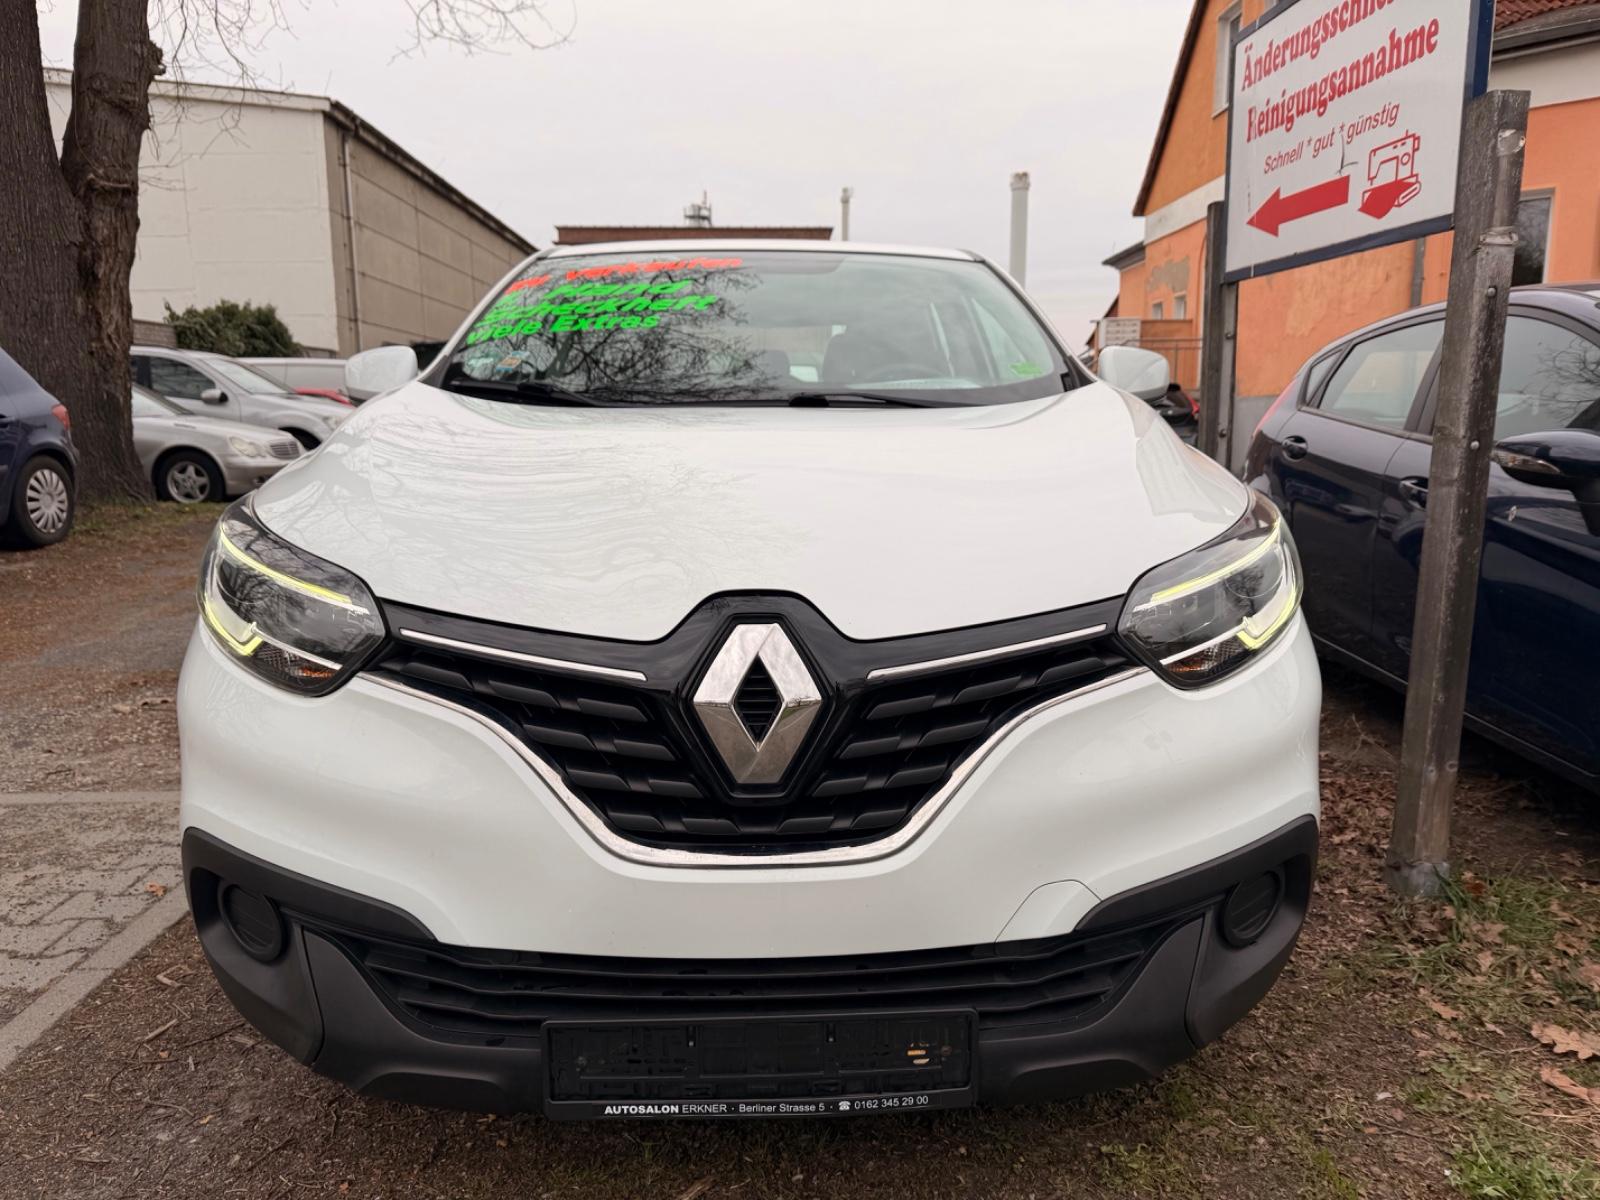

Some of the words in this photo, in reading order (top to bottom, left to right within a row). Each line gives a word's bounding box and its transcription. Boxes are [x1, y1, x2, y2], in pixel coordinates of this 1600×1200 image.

[1241, 0, 1394, 92] Änderungsschn
[1246, 18, 1440, 143] Reinigungsannahme
[1263, 141, 1304, 174] Schnell
[1312, 127, 1336, 158] gut
[1346, 102, 1401, 145] günstig
[551, 315, 661, 334] Extras
[604, 1105, 679, 1115] AUTOSALON
[682, 1104, 728, 1114] ERKNER
[738, 1103, 776, 1113] Berliner
[779, 1102, 816, 1113] Strasse
[818, 1102, 826, 1112] 5
[854, 1099, 879, 1110] 0162
[881, 1097, 900, 1108] 345
[901, 1096, 915, 1107] 29
[917, 1094, 929, 1105] 00
